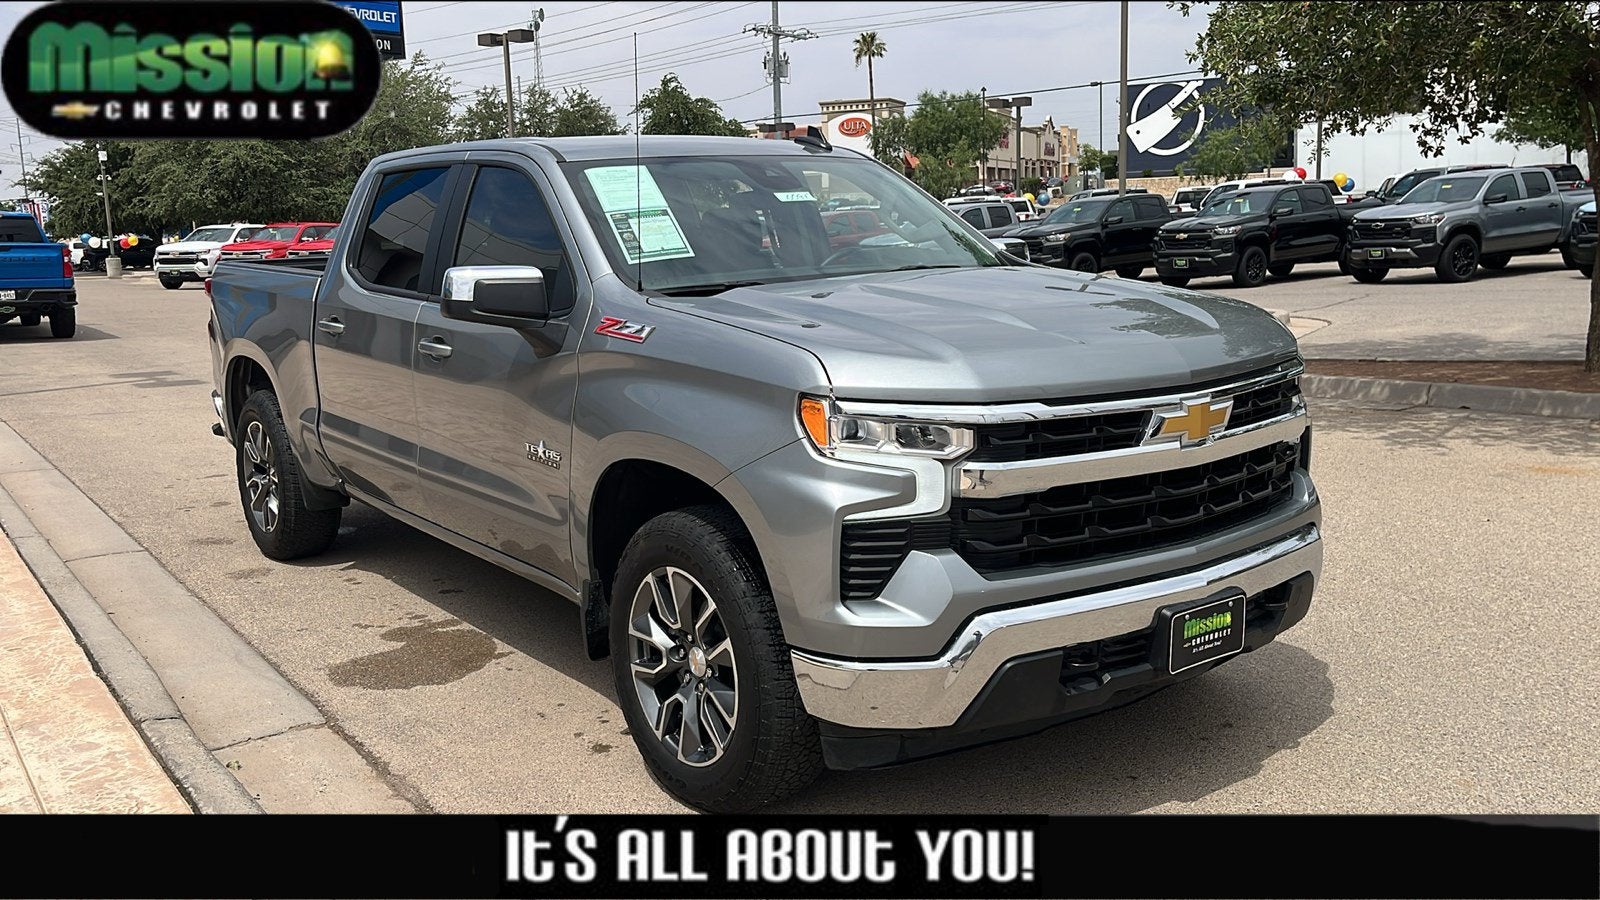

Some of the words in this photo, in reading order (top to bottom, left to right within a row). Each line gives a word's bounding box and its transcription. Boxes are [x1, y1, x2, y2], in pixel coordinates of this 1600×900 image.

[843, 121, 867, 130] ULTA
[592, 315, 657, 344] Z71
[524, 440, 562, 462] TEXAS
[1183, 611, 1232, 640] Mission
[1191, 628, 1232, 646] CHEVROLET
